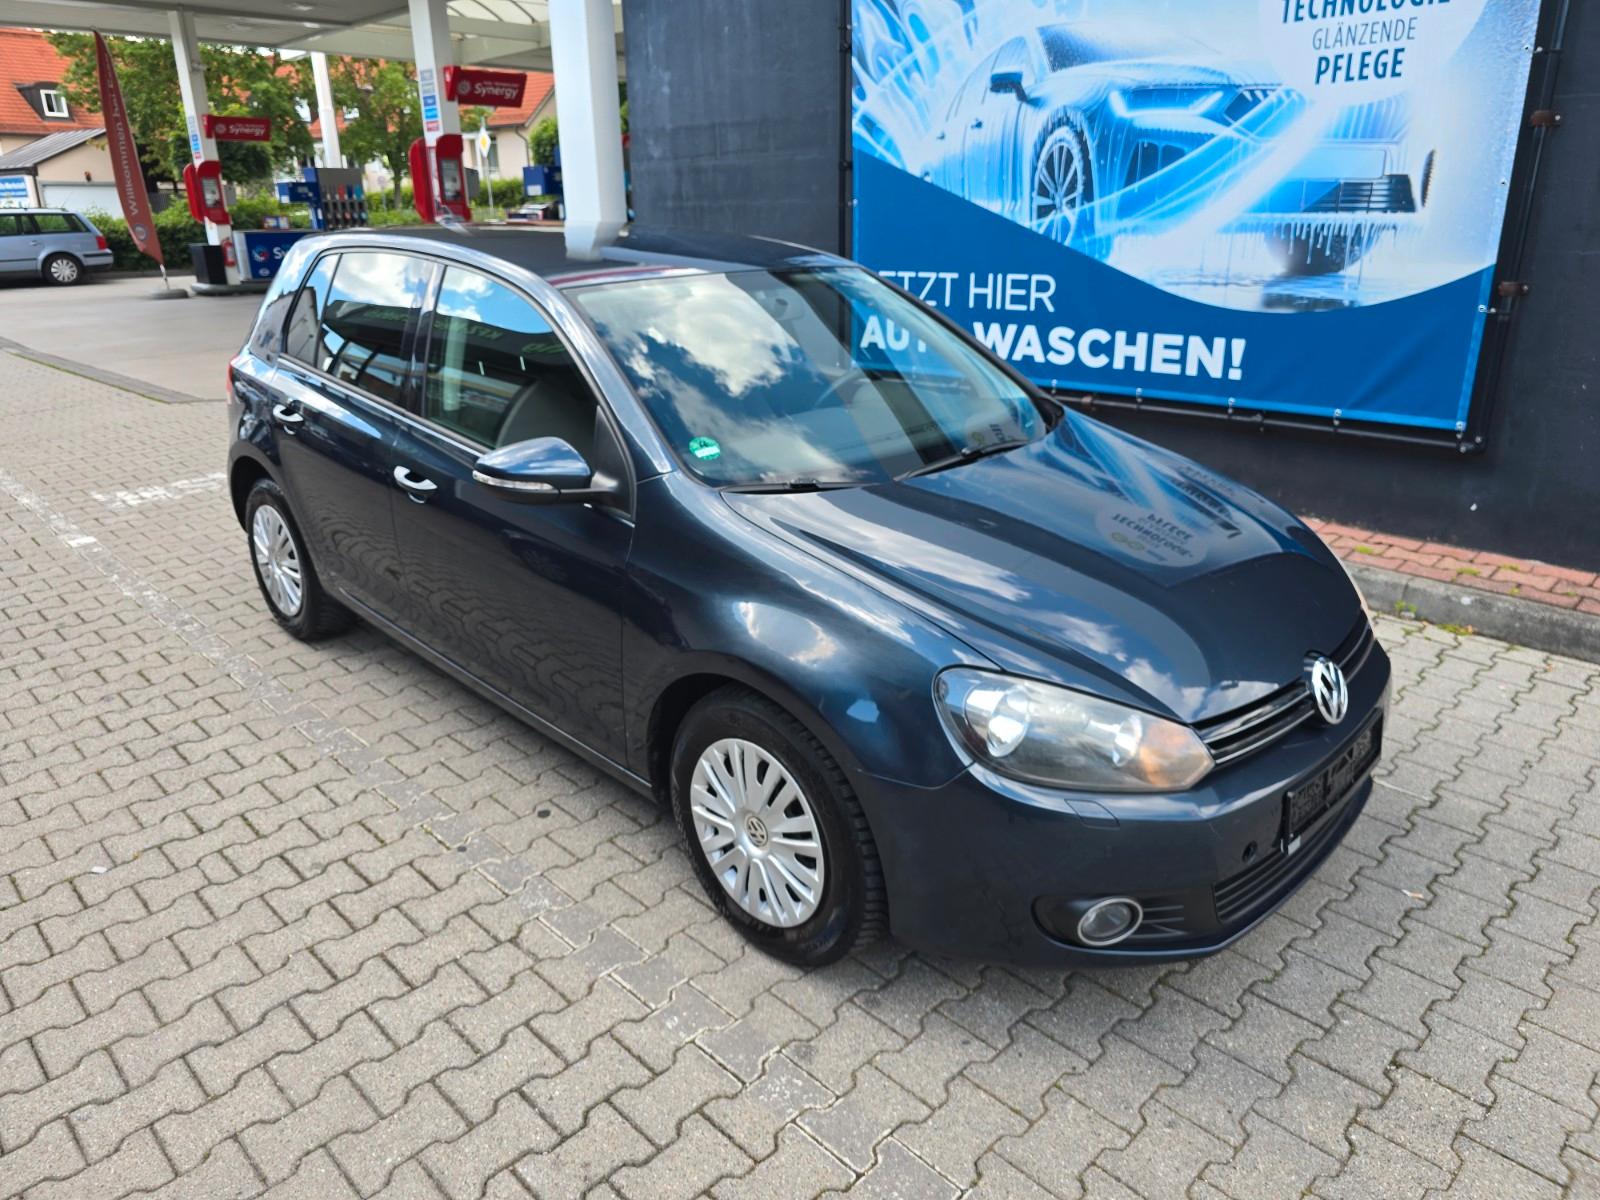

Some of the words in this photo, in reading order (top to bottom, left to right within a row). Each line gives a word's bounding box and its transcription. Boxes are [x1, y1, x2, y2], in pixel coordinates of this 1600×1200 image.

[1312, 16, 1418, 51] GLÄNZENDE
[1314, 47, 1406, 85] PFLEGE
[474, 82, 519, 100] Synergy
[229, 124, 266, 137] Synergy
[116, 121, 139, 216] Willkommen
[969, 272, 1056, 312] HIER
[973, 321, 1247, 381] WASCHEN!
